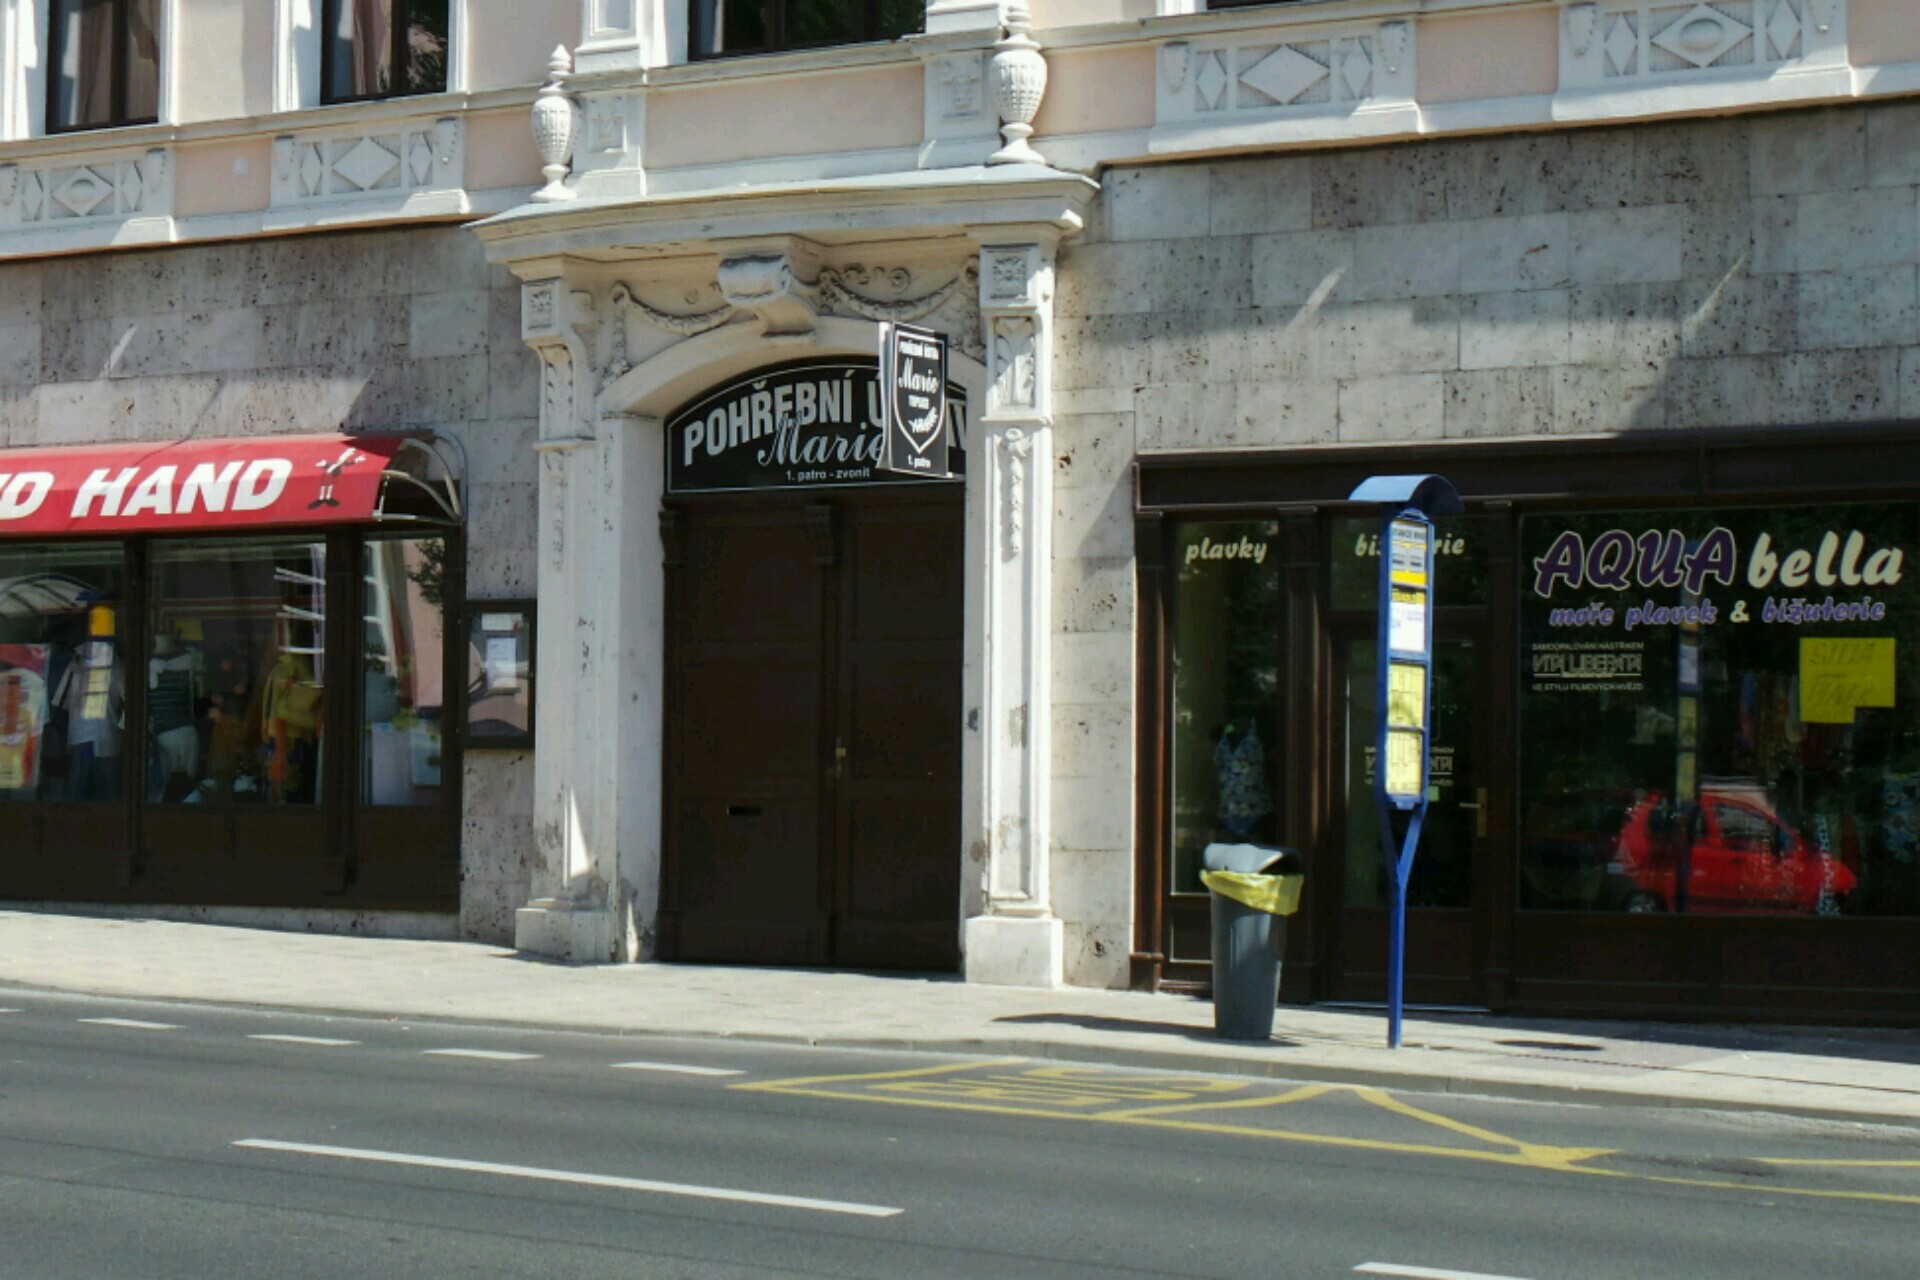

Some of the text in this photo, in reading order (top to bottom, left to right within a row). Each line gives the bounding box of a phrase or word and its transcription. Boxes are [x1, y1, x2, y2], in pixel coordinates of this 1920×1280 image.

[684, 369, 856, 467] POHŘEBNÍ
[757, 411, 884, 467] Marie
[0, 458, 293, 520] D HAND
[786, 470, 796, 481] 1.
[797, 468, 827, 482] patro
[835, 466, 870, 479] zvonit
[1185, 536, 1267, 564] plavky
[1534, 527, 1903, 599] AQUA bella
[1625, 600, 1718, 630] plavek
[1729, 600, 1750, 623] &
[1761, 596, 1886, 625] bižuterie
[866, 1066, 1251, 1107] BUS
